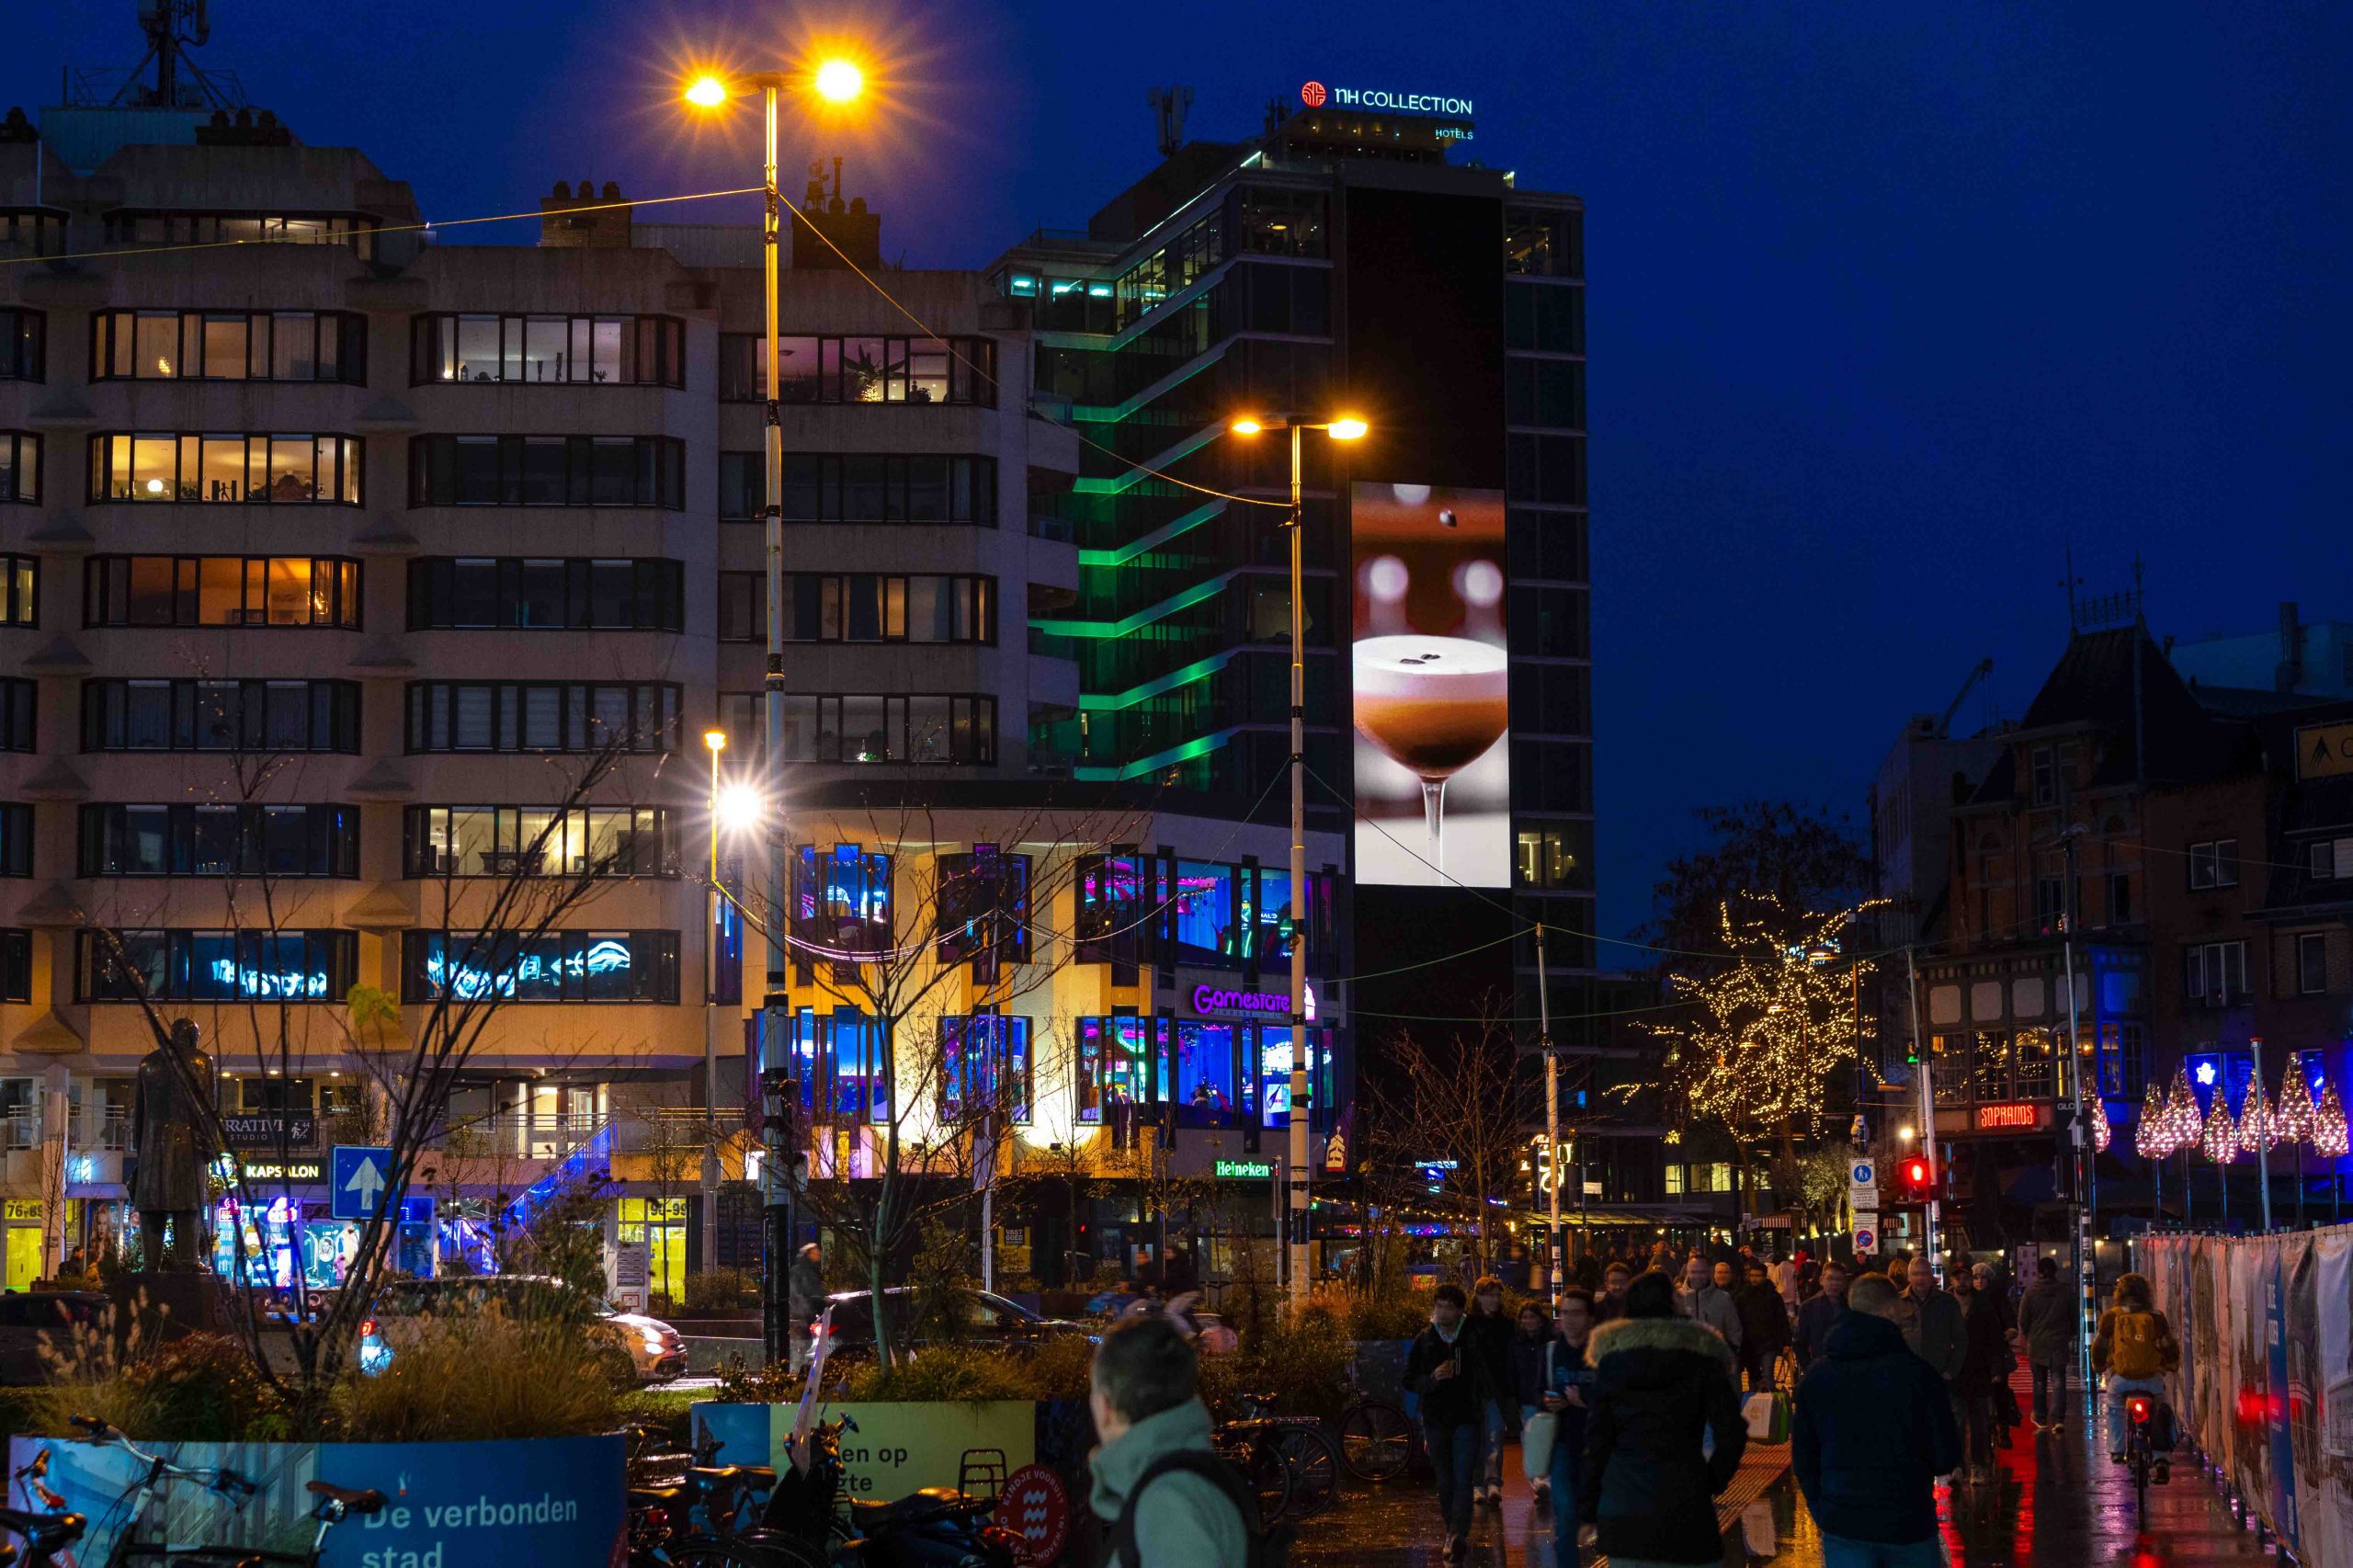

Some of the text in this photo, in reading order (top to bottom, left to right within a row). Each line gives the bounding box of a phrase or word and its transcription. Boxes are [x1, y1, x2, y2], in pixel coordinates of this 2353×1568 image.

[1363, 91, 1472, 115] COLLECTION
[1436, 128, 1473, 139] HOTELS
[1981, 1105, 2033, 1127] SOPRANOS
[1216, 1161, 1269, 1176] Heineken
[879, 1449, 908, 1468] op
[364, 1493, 577, 1529] De verbonden
[361, 1541, 443, 1568] stad
